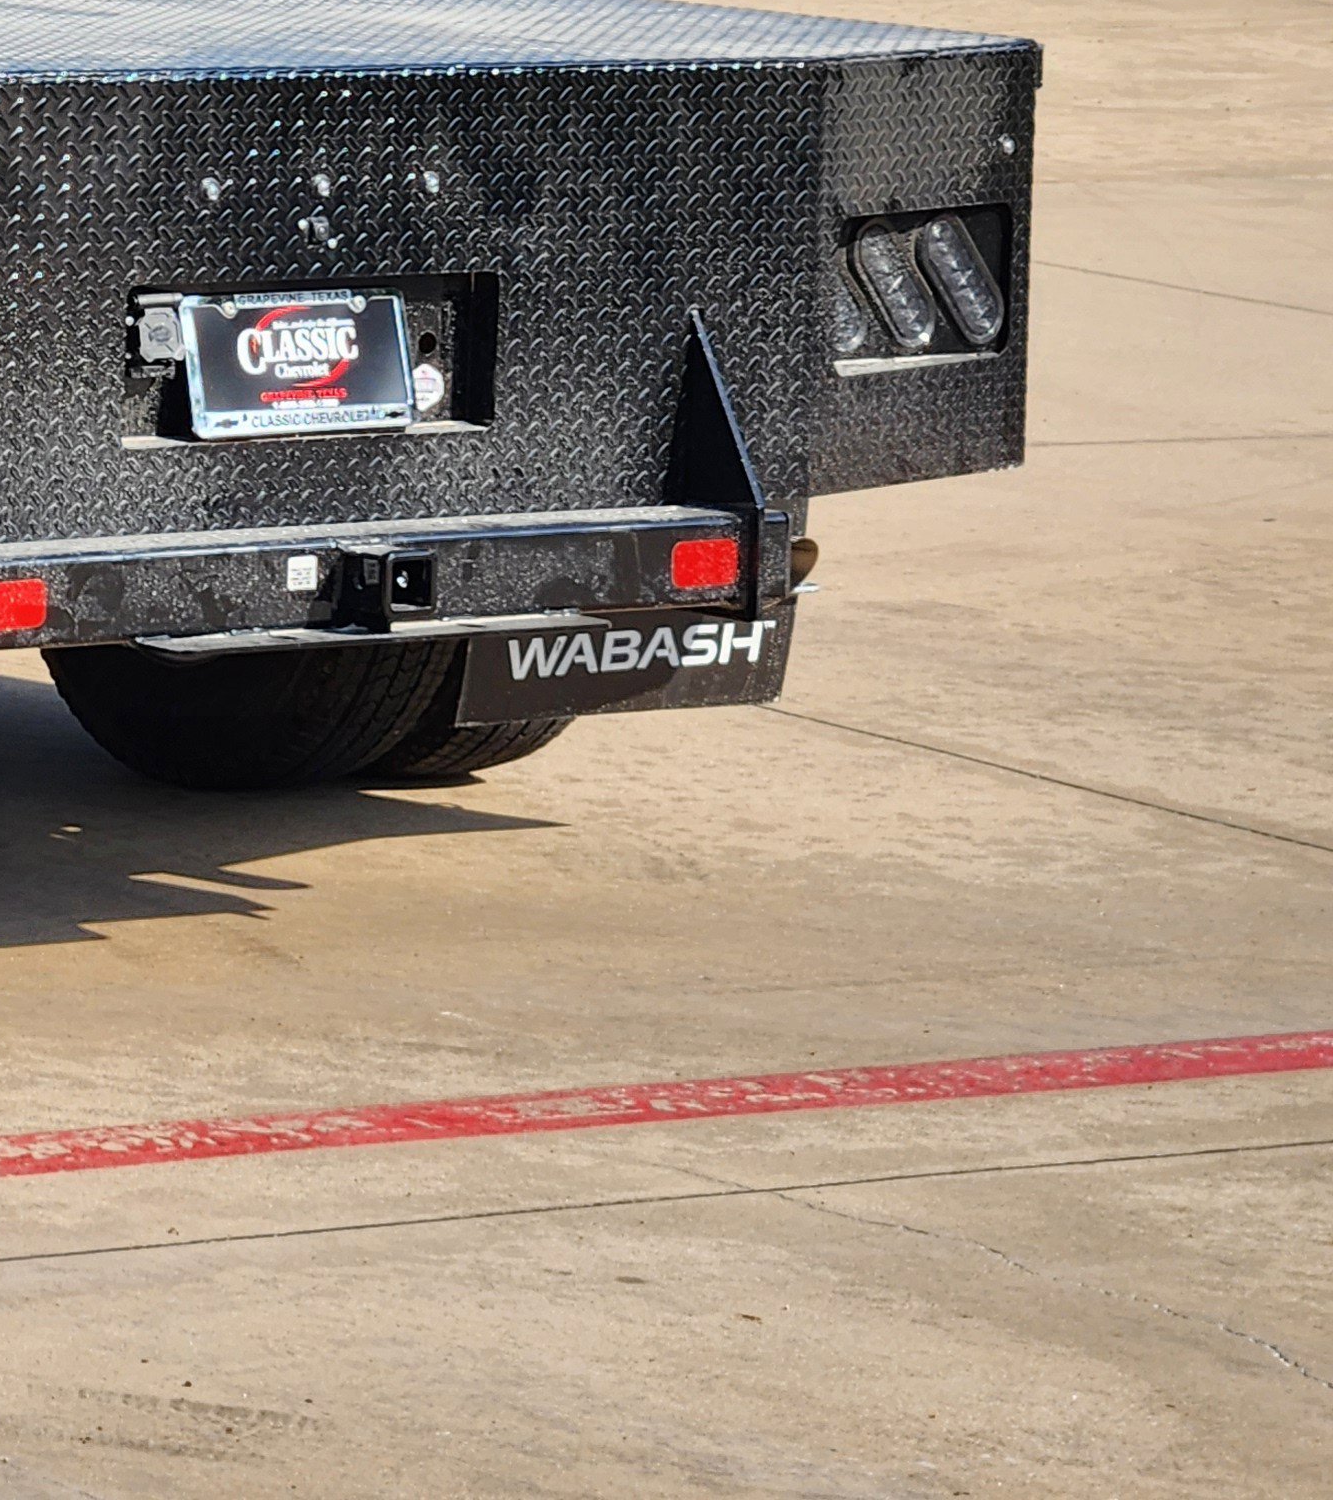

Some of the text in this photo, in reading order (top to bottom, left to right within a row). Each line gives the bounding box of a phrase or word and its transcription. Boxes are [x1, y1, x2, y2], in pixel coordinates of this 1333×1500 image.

[238, 290, 349, 305] GRAPEVINE TEXAS
[237, 326, 359, 375] CLASSIC
[251, 410, 369, 428] CLASSIC CHEVROLET
[508, 622, 766, 681] WABASH
